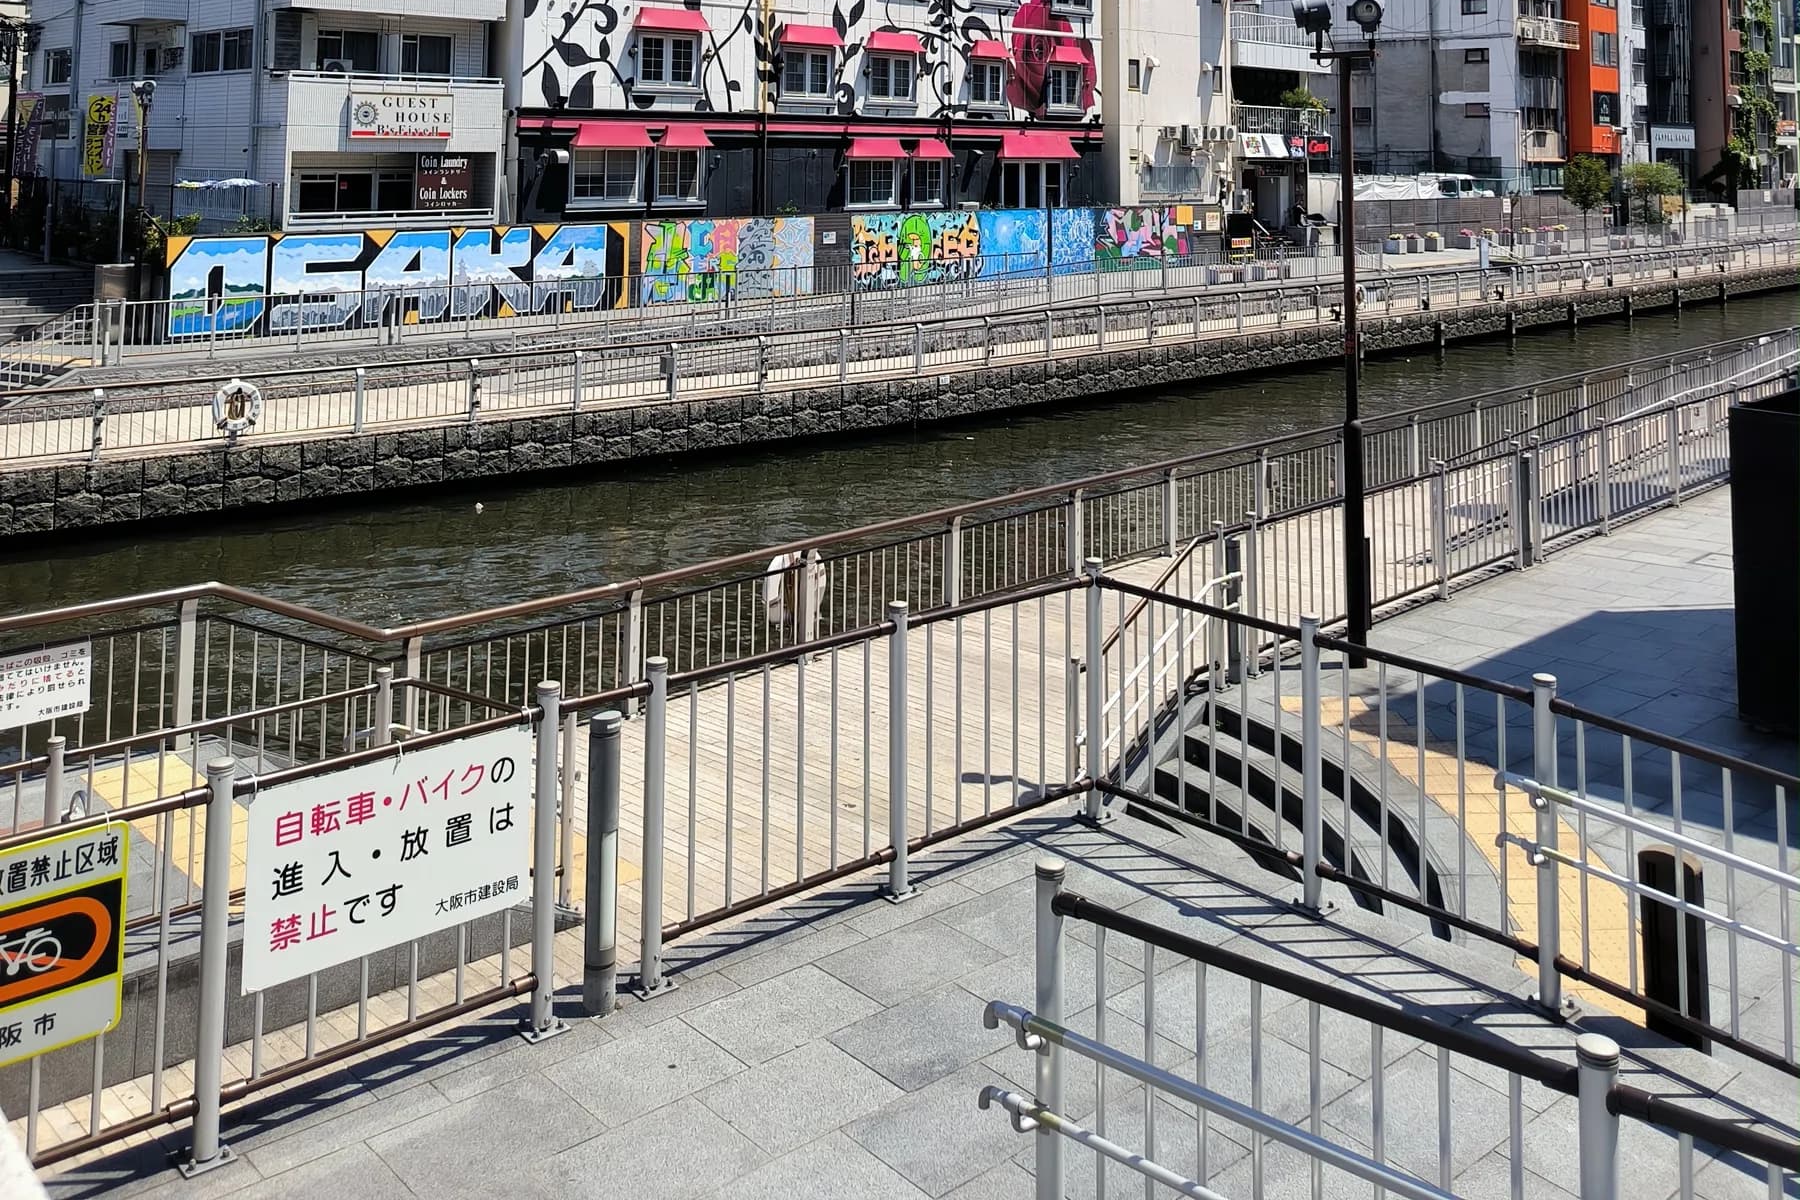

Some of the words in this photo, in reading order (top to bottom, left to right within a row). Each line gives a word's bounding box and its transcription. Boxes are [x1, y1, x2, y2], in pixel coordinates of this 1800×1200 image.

[94, 103, 112, 114] 24
[382, 96, 439, 109] GUEST
[98, 113, 106, 122] h
[395, 111, 452, 124] HOUSE
[421, 155, 438, 168] Coin
[440, 155, 469, 169] Laundry
[419, 187, 437, 200] Coin
[439, 186, 468, 200] Lockers
[167, 223, 608, 338] OSAKA
[38, 700, 84, 716] 大阪市建設局
[274, 756, 516, 847] 自転車・バイクの
[0, 836, 119, 895] 置禁止区域
[434, 875, 519, 916] 大阪市建設局
[270, 883, 404, 952] 禁止です
